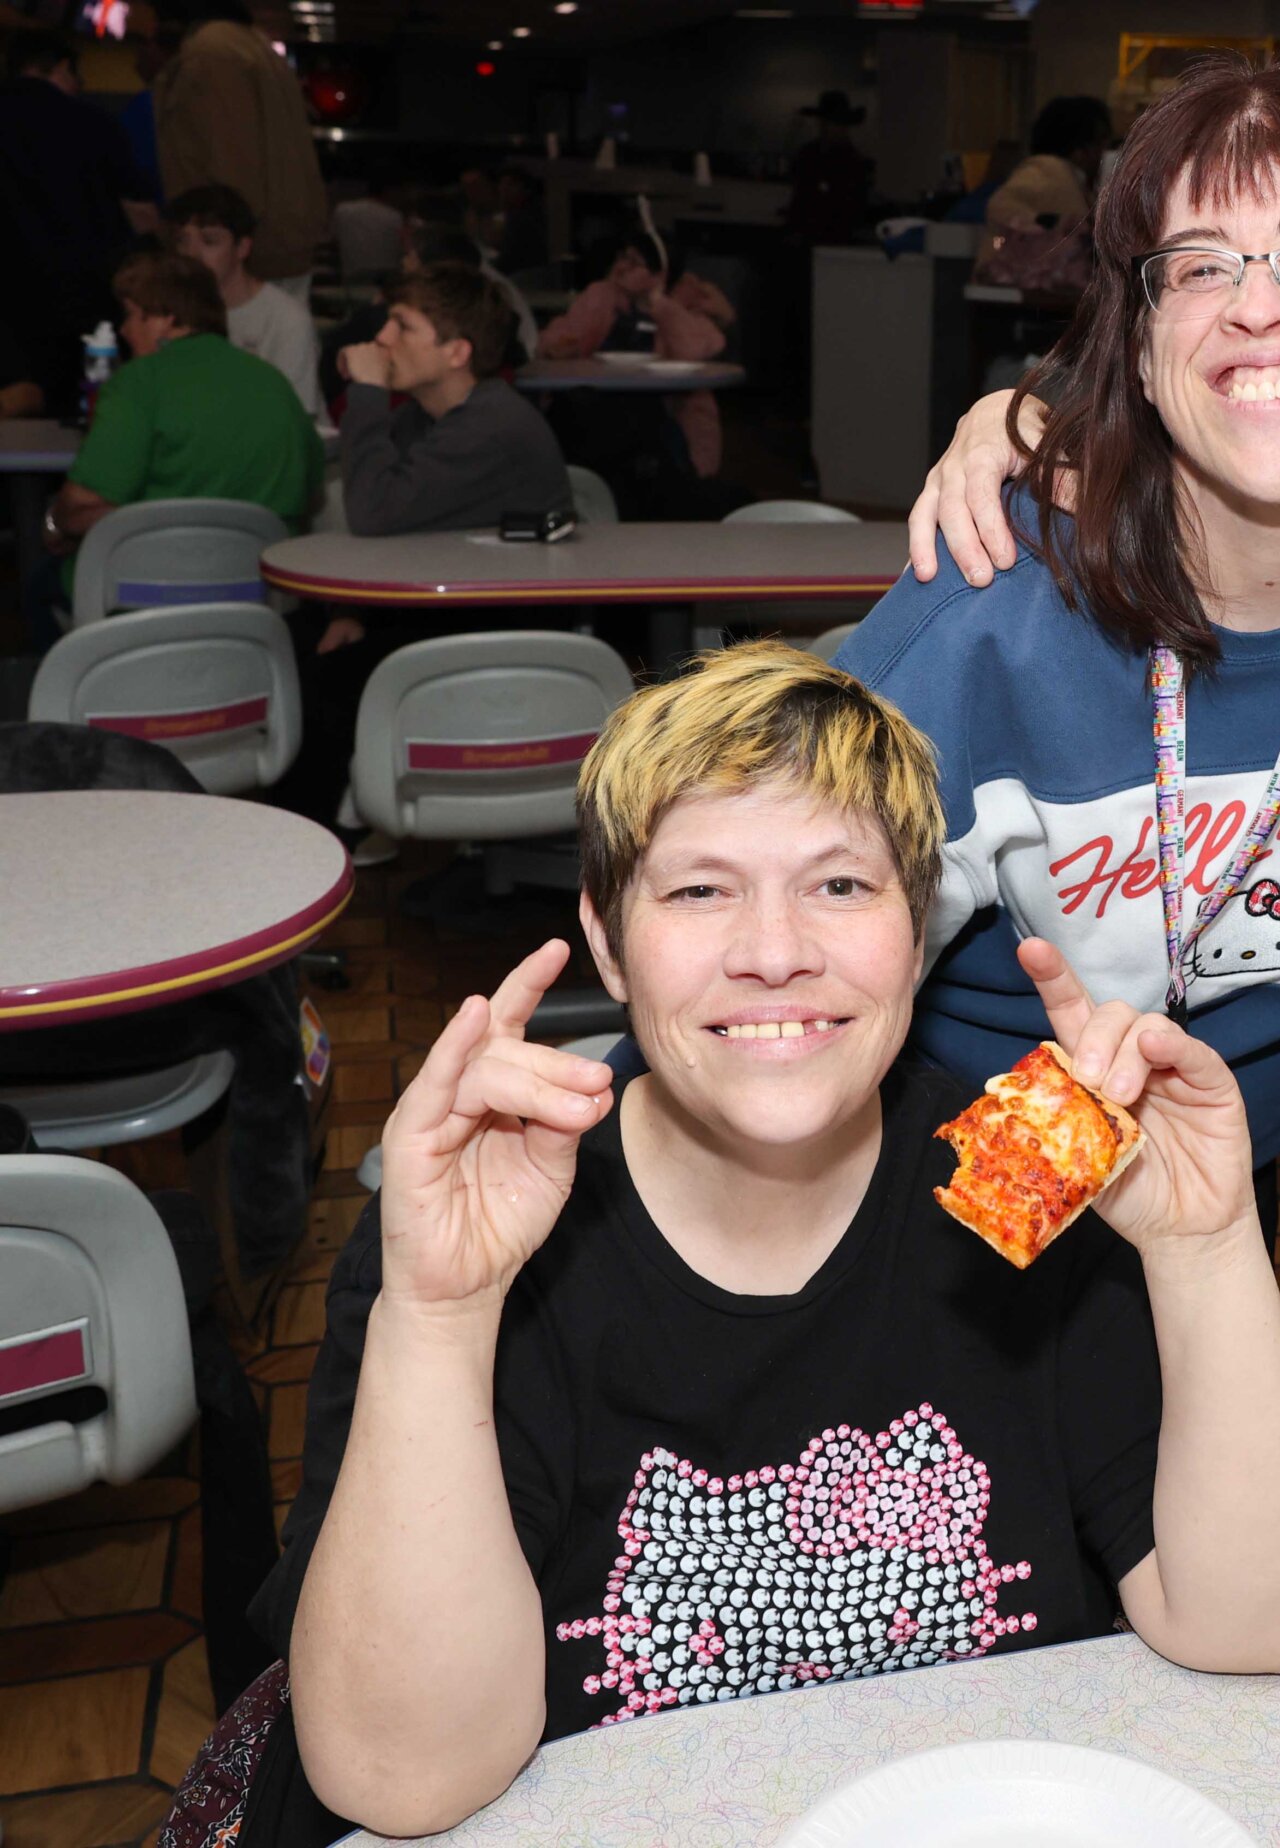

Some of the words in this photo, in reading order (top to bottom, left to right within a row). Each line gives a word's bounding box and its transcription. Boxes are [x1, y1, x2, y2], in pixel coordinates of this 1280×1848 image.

[1176, 691, 1184, 720] GERMANY
[1176, 740, 1184, 761] BERLIN
[1267, 772, 1279, 793] BERLIN
[1246, 811, 1263, 837] GERMANY
